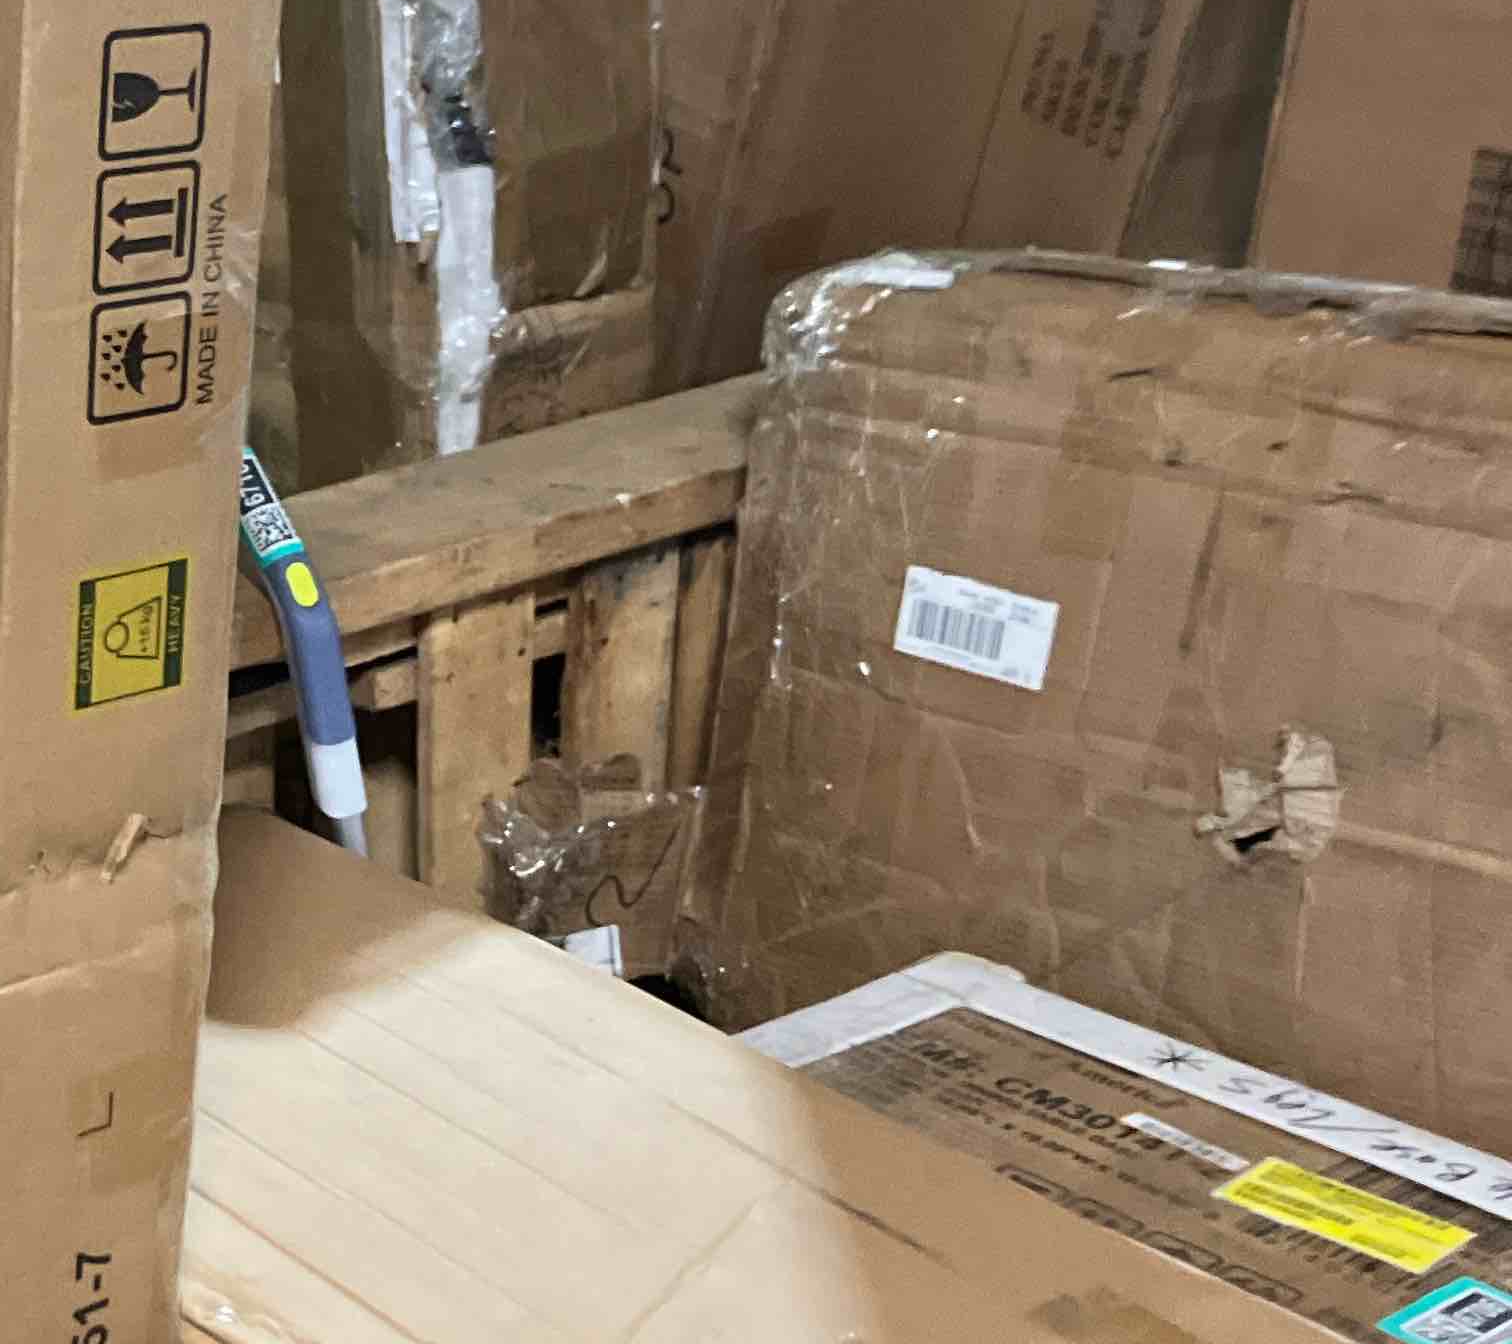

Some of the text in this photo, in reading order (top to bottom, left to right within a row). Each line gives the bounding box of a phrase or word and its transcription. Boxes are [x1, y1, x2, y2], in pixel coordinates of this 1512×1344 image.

[194, 193, 228, 405] MADE IN CHINA
[79, 602, 94, 684] CAUTION
[168, 593, 183, 654] HEAVY
